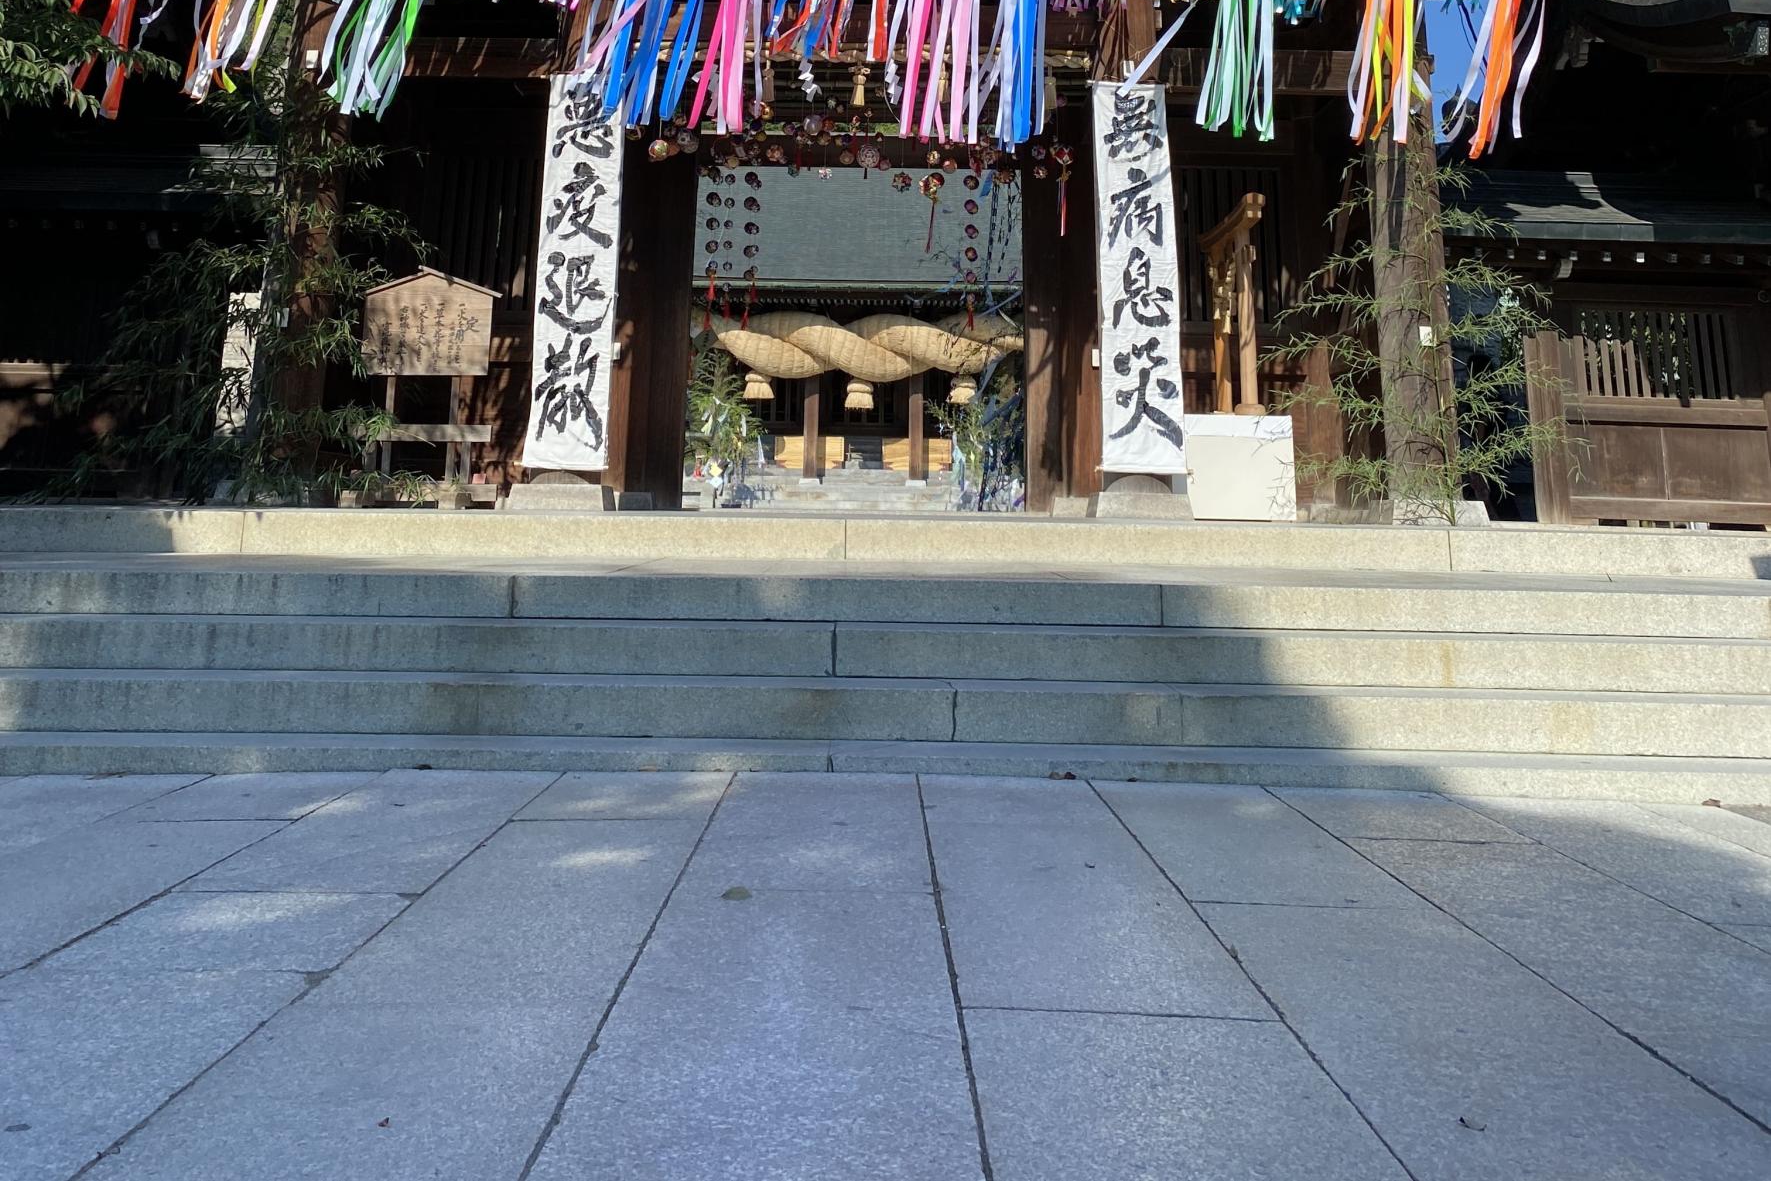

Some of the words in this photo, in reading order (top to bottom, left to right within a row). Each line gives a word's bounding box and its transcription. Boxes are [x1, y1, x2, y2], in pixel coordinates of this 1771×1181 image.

[464, 316, 481, 333] 定
[535, 82, 614, 452] 悪疫退散
[1103, 86, 1183, 451] 無病息災
